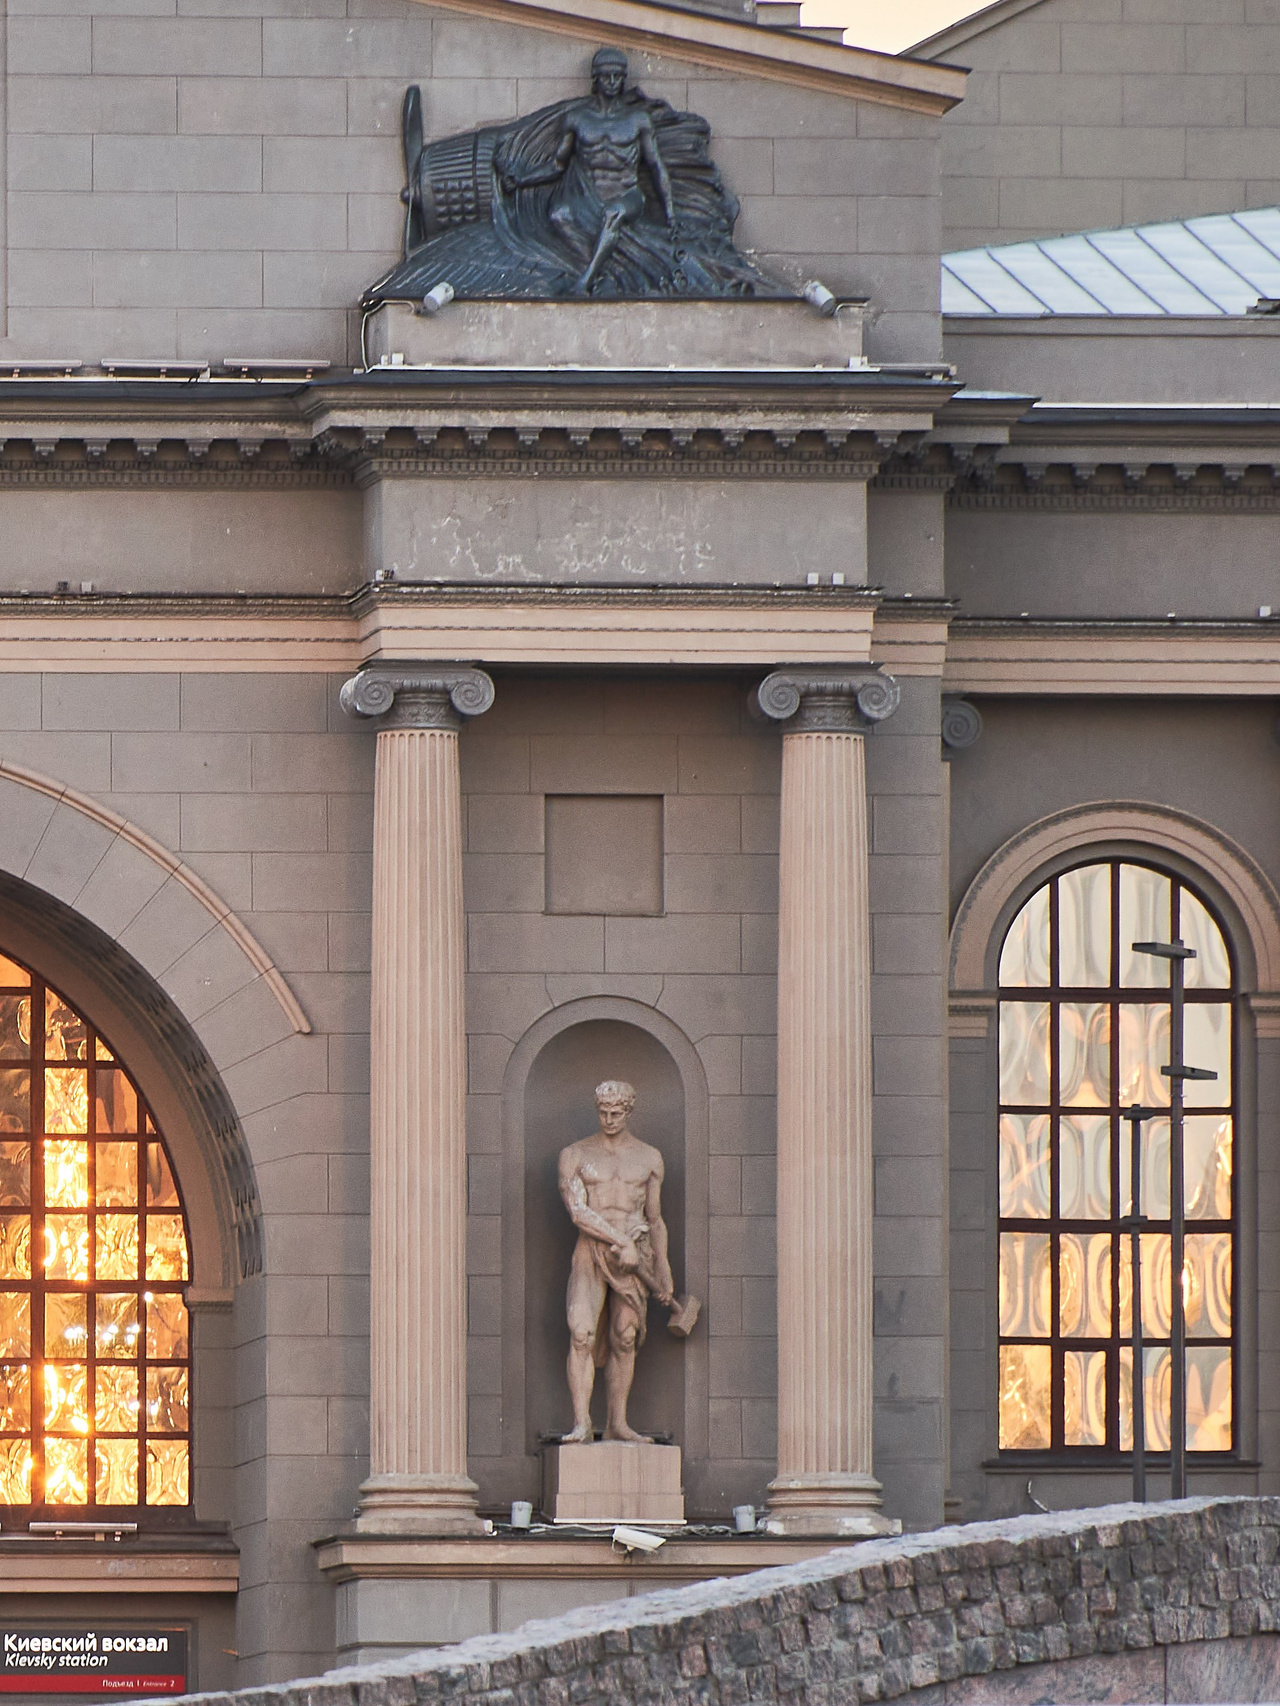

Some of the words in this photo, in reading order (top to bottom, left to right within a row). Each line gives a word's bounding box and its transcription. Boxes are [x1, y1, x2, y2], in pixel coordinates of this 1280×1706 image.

[4, 1632, 97, 1652] Киевский
[102, 1636, 168, 1652] вокзал
[5, 1652, 56, 1670] Kievsky
[59, 1653, 108, 1667] station
[102, 1679, 134, 1688] Подъезд
